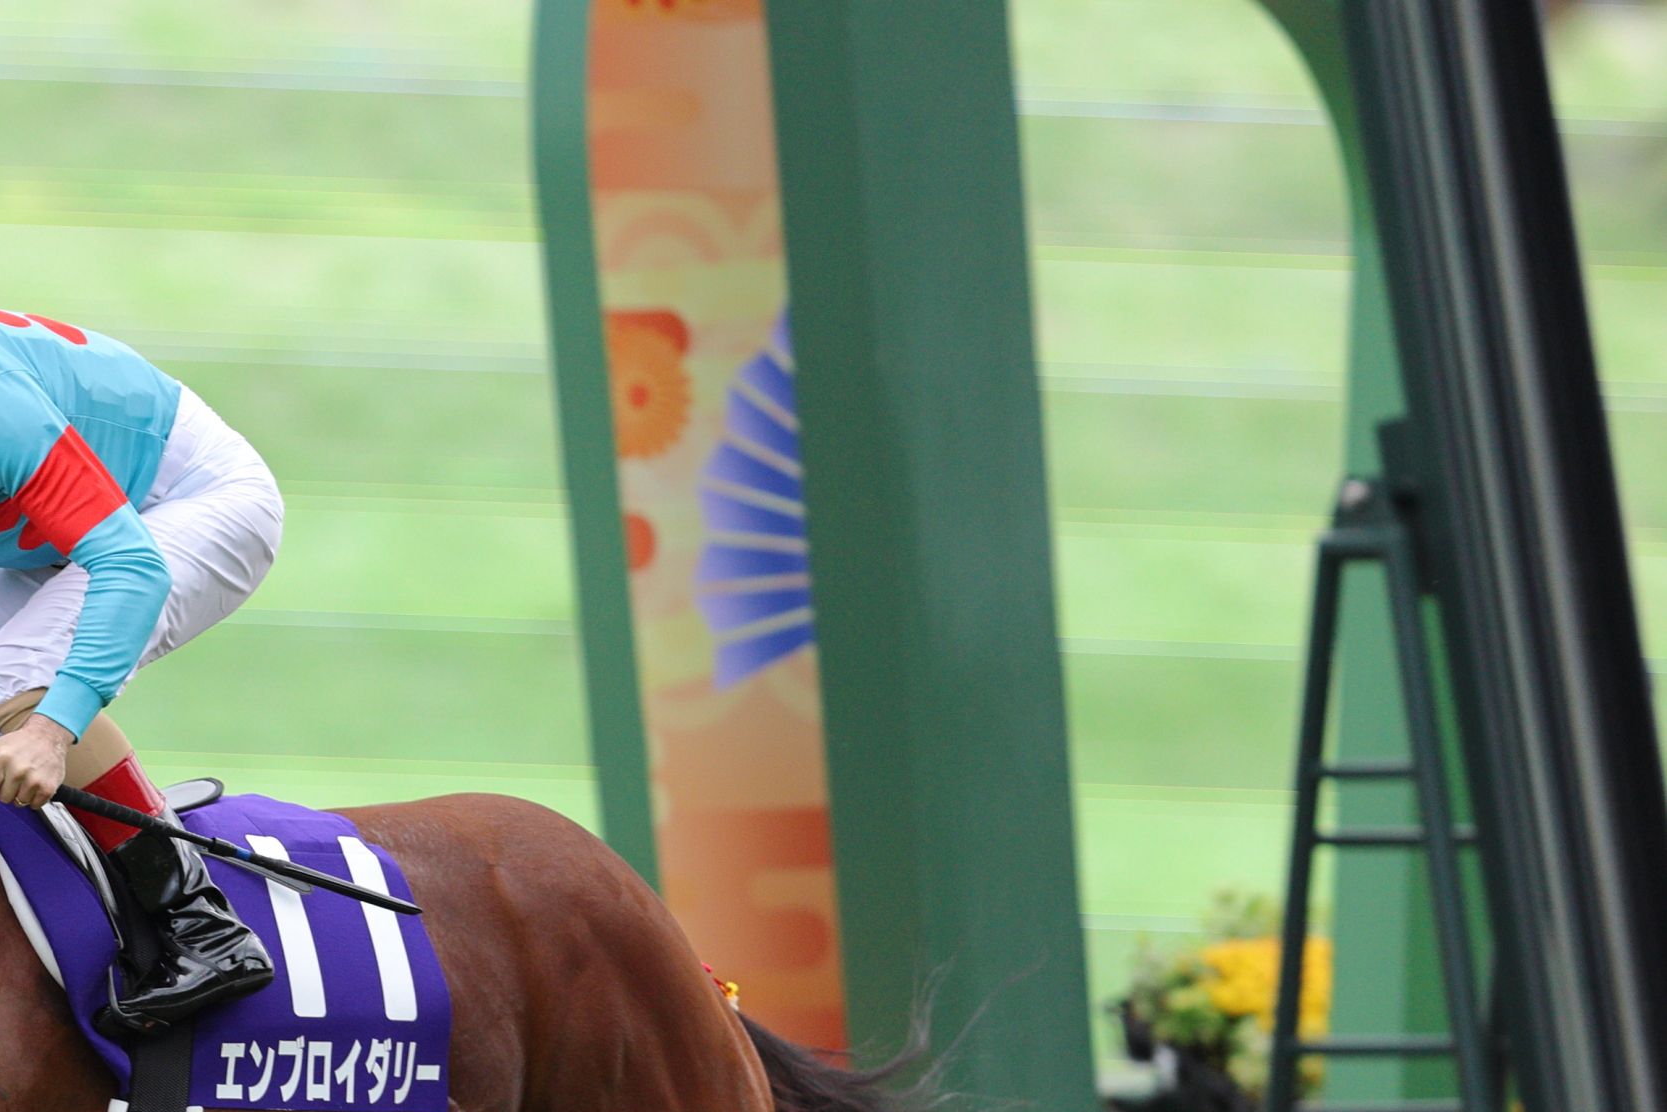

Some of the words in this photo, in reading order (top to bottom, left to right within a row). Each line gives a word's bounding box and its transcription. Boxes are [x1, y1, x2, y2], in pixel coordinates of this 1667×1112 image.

[246, 834, 418, 1021] 11
[216, 1036, 441, 1105] エンブロイダリー
